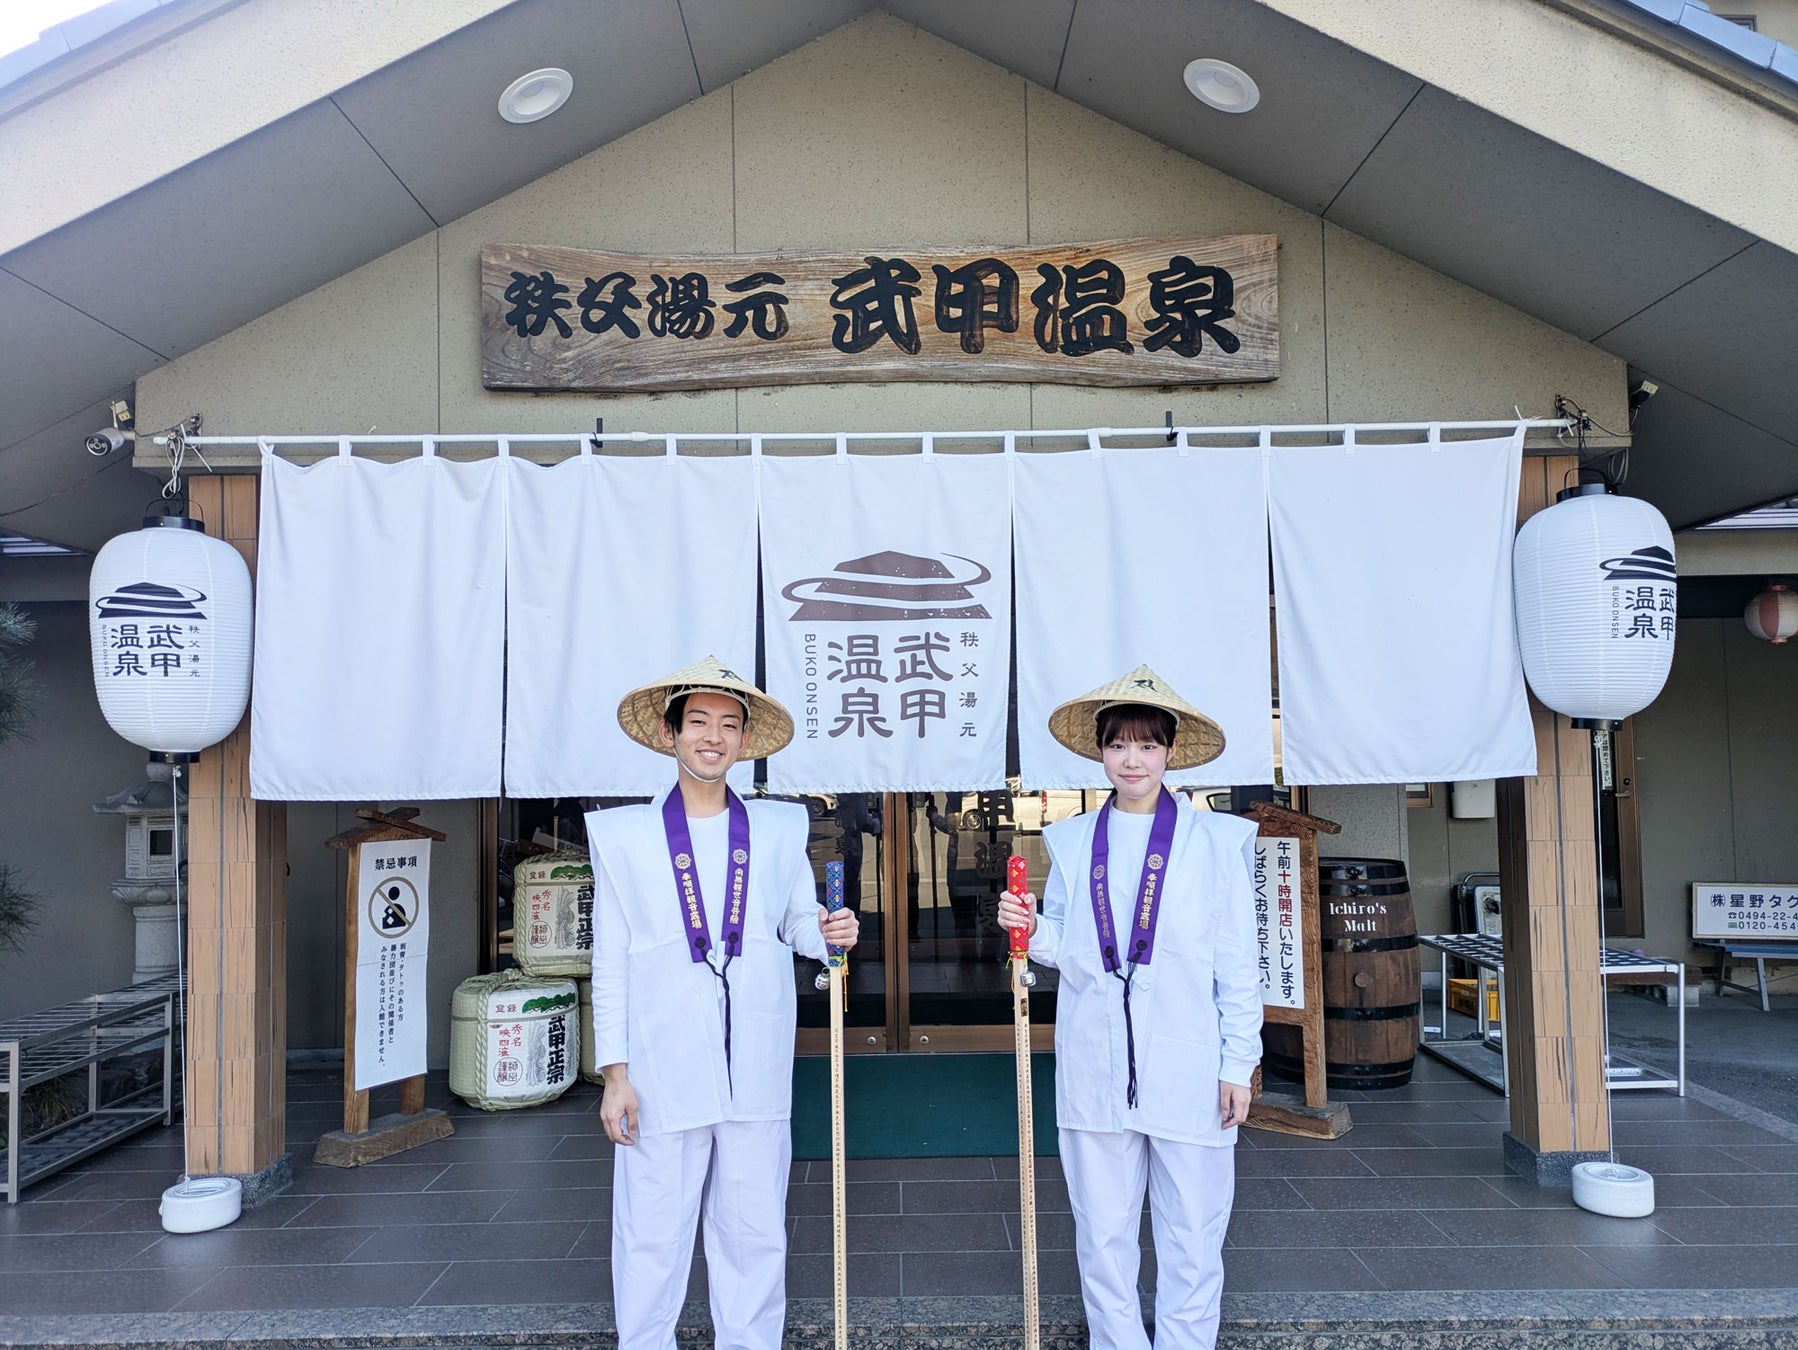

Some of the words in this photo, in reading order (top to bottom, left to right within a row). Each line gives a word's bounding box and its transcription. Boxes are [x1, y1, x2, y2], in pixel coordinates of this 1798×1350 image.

[504, 271, 790, 341] 秩父湯元
[830, 257, 1241, 358] 武甲温泉
[1624, 587, 1659, 639] 温泉
[1659, 587, 1675, 641] 武甲
[111, 624, 148, 676] 温泉
[147, 624, 185, 677] 武甲
[188, 625, 200, 677] 秩父湯元
[826, 634, 894, 738] 温泉
[894, 631, 954, 738] 武甲
[959, 631, 979, 738] 秩父湯元
[374, 855, 417, 871] 禁忌事項
[576, 884, 595, 950] 武甲正宗
[1277, 840, 1295, 1005] 午前十時開店いたします。
[1329, 902, 1387, 916] Ichiro's
[1344, 919, 1377, 932] Malt
[1738, 921, 1796, 930] 0120-454
[547, 1015, 565, 1085] 武甲正宗
